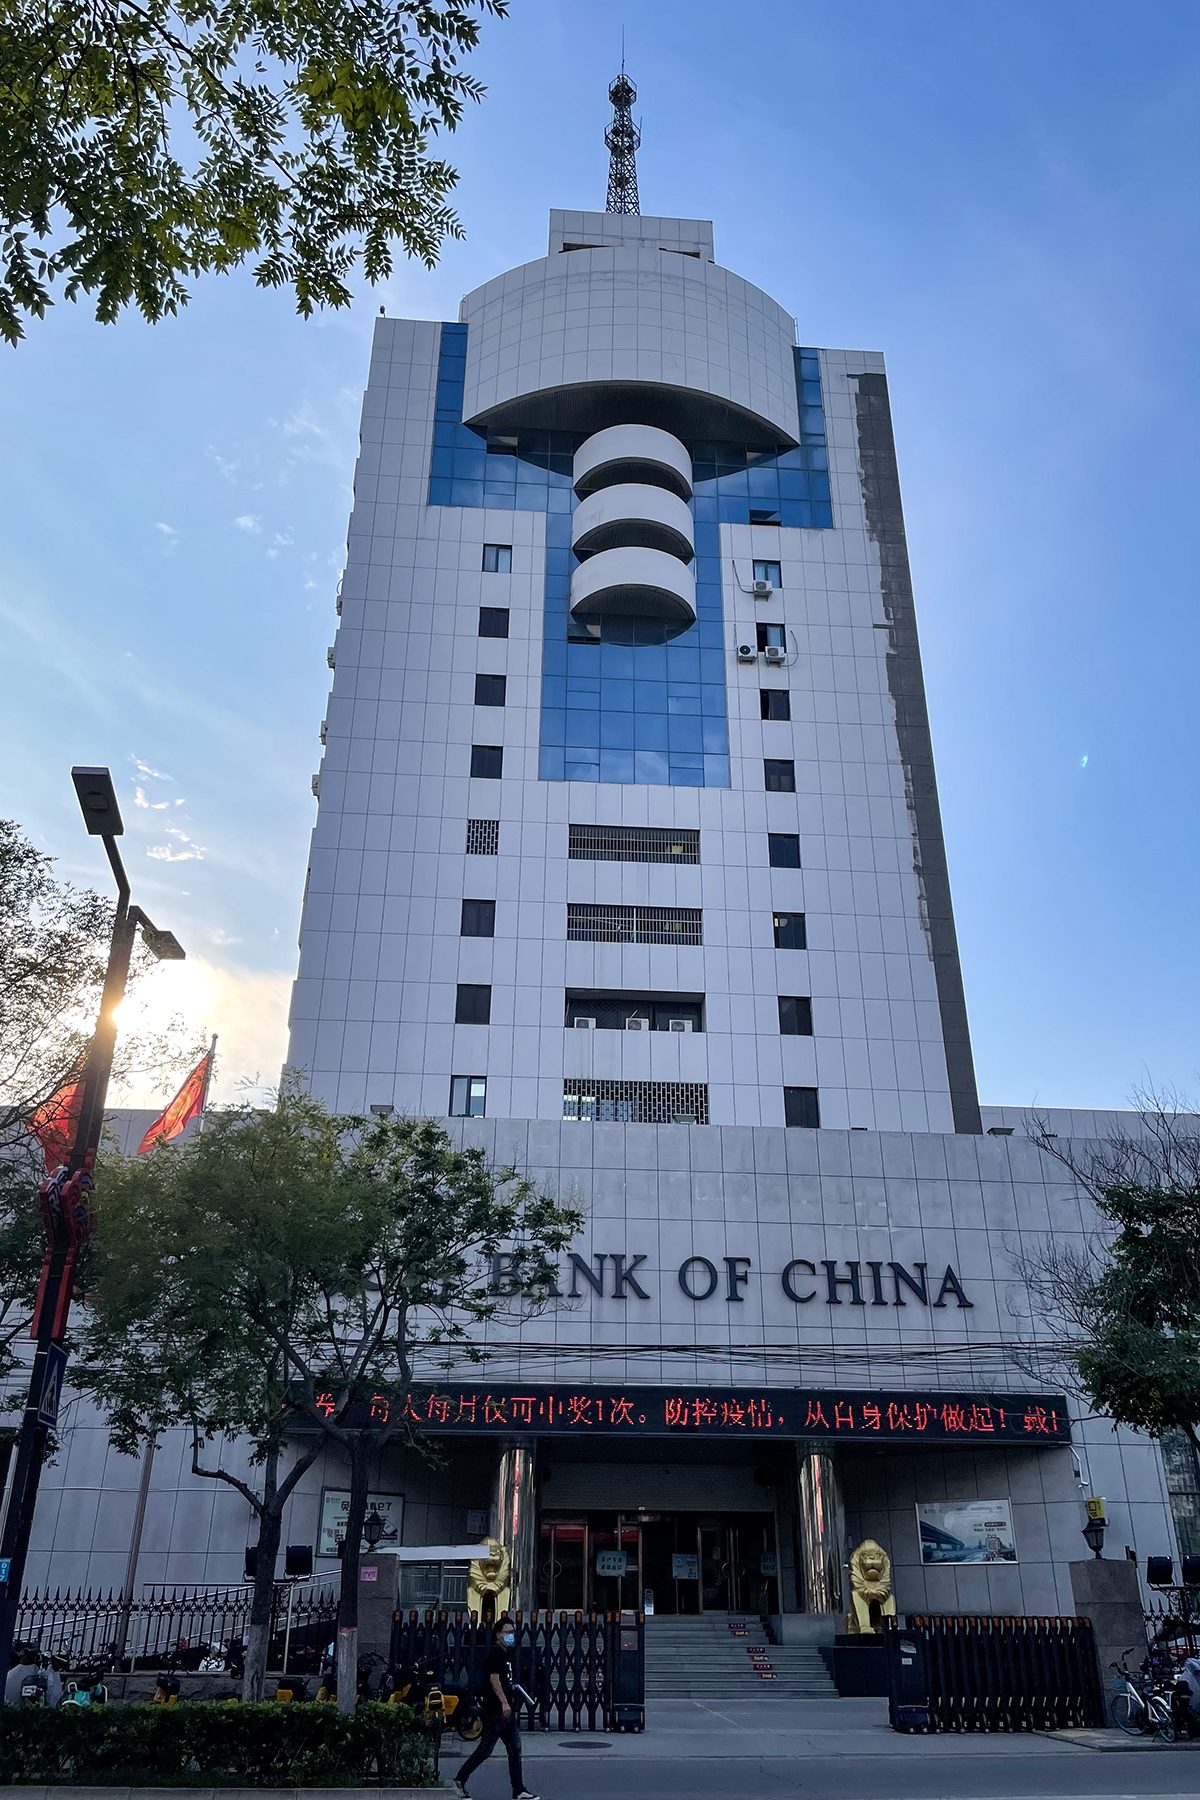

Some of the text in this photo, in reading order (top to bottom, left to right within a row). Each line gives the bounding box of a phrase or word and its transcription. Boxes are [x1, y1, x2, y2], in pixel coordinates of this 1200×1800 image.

[489, 1252, 650, 1299] BANK
[678, 1256, 752, 1301] OF
[782, 1259, 975, 1308] CHINA
